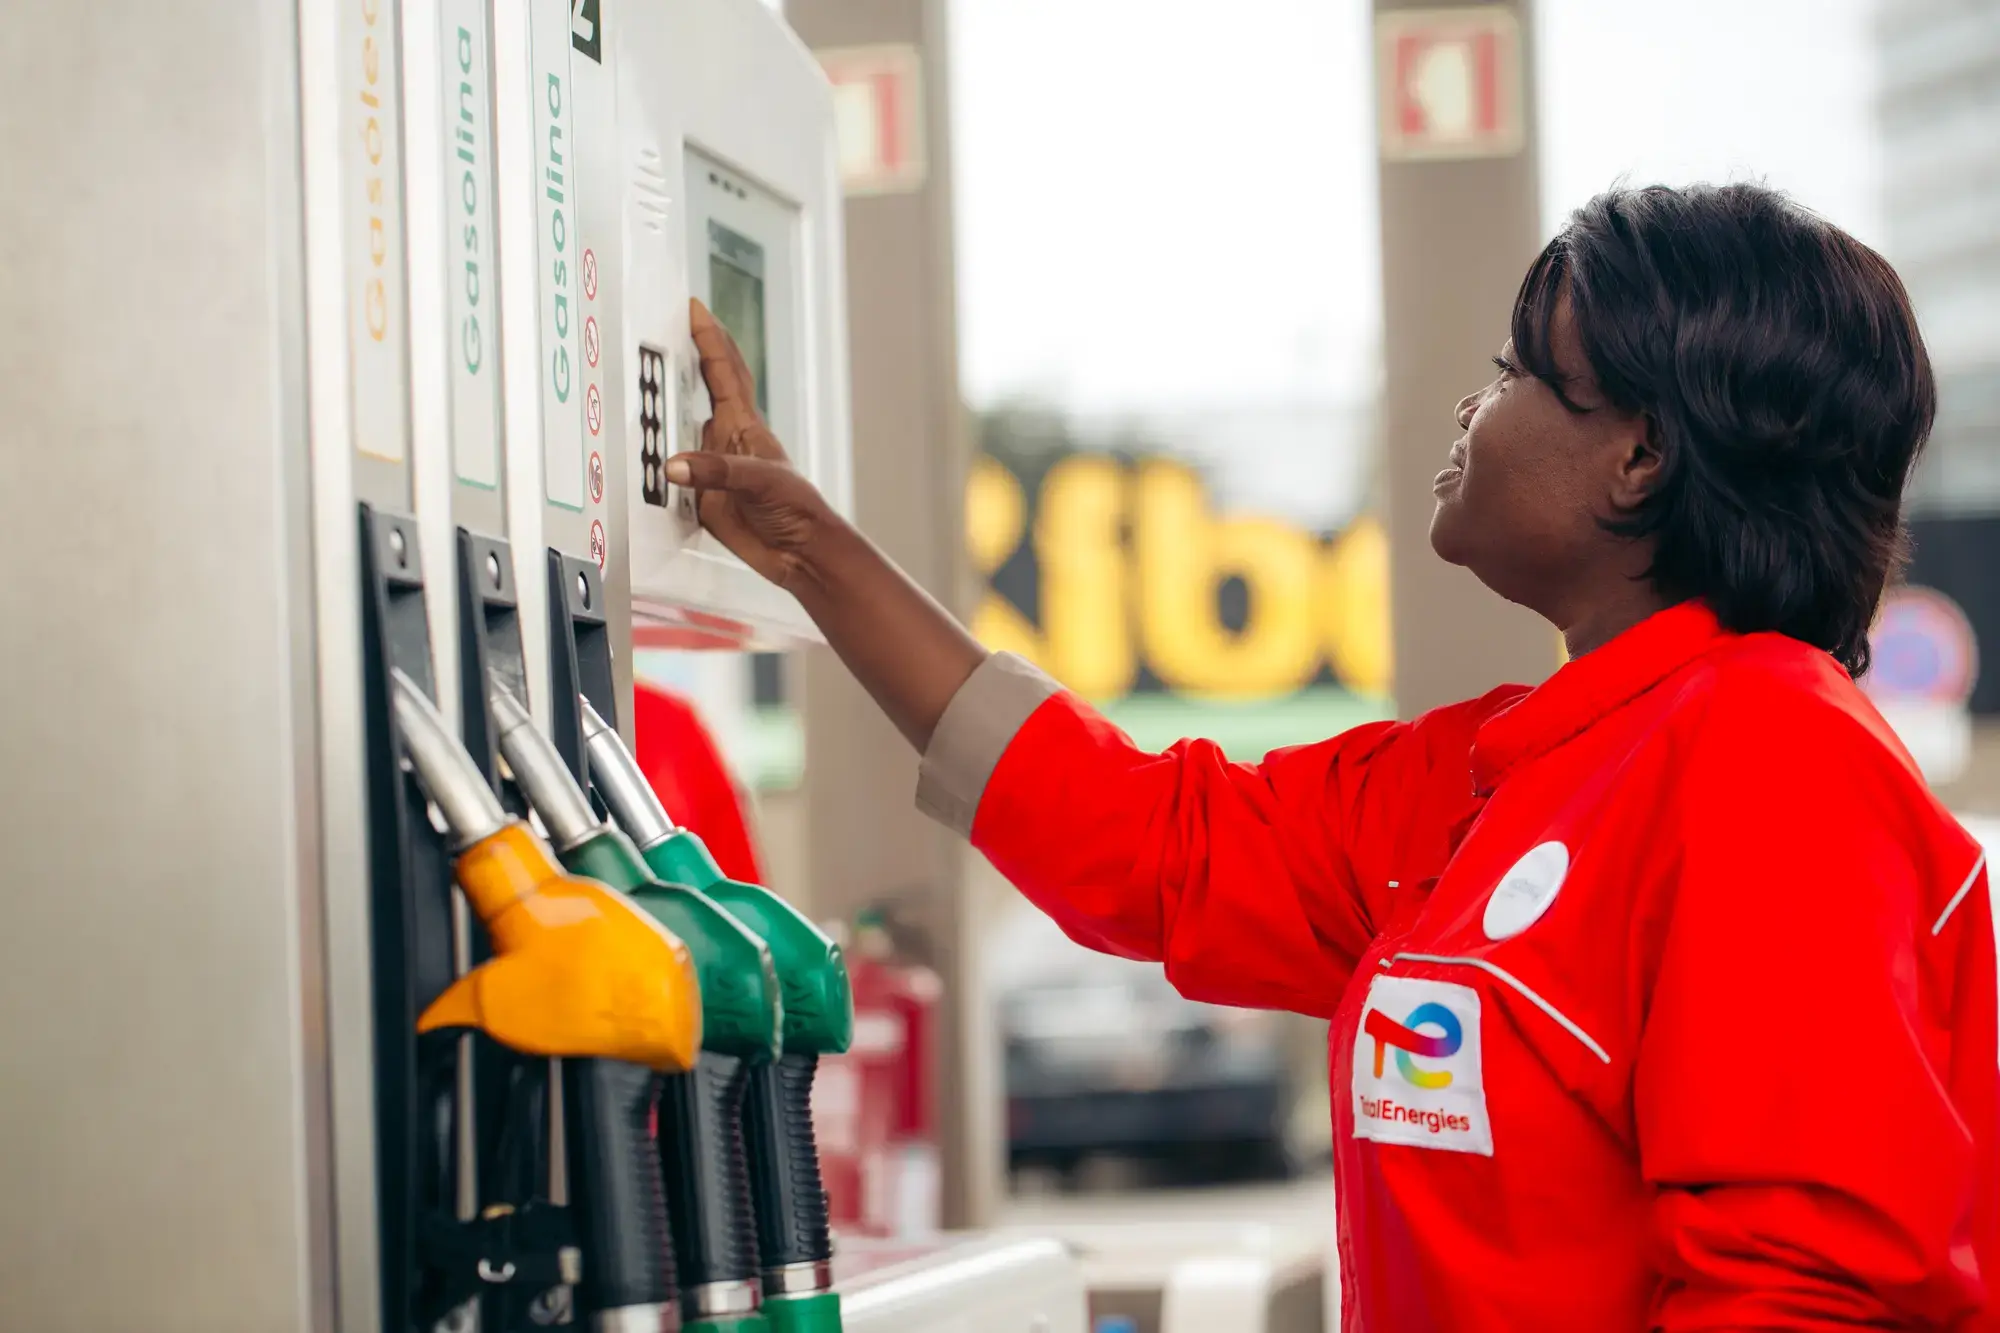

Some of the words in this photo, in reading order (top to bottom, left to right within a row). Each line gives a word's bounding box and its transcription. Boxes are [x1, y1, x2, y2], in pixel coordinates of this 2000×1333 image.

[457, 26, 482, 374] Gasolina
[546, 73, 570, 402] Gasolina
[1359, 1095, 1470, 1133] alEnergies
